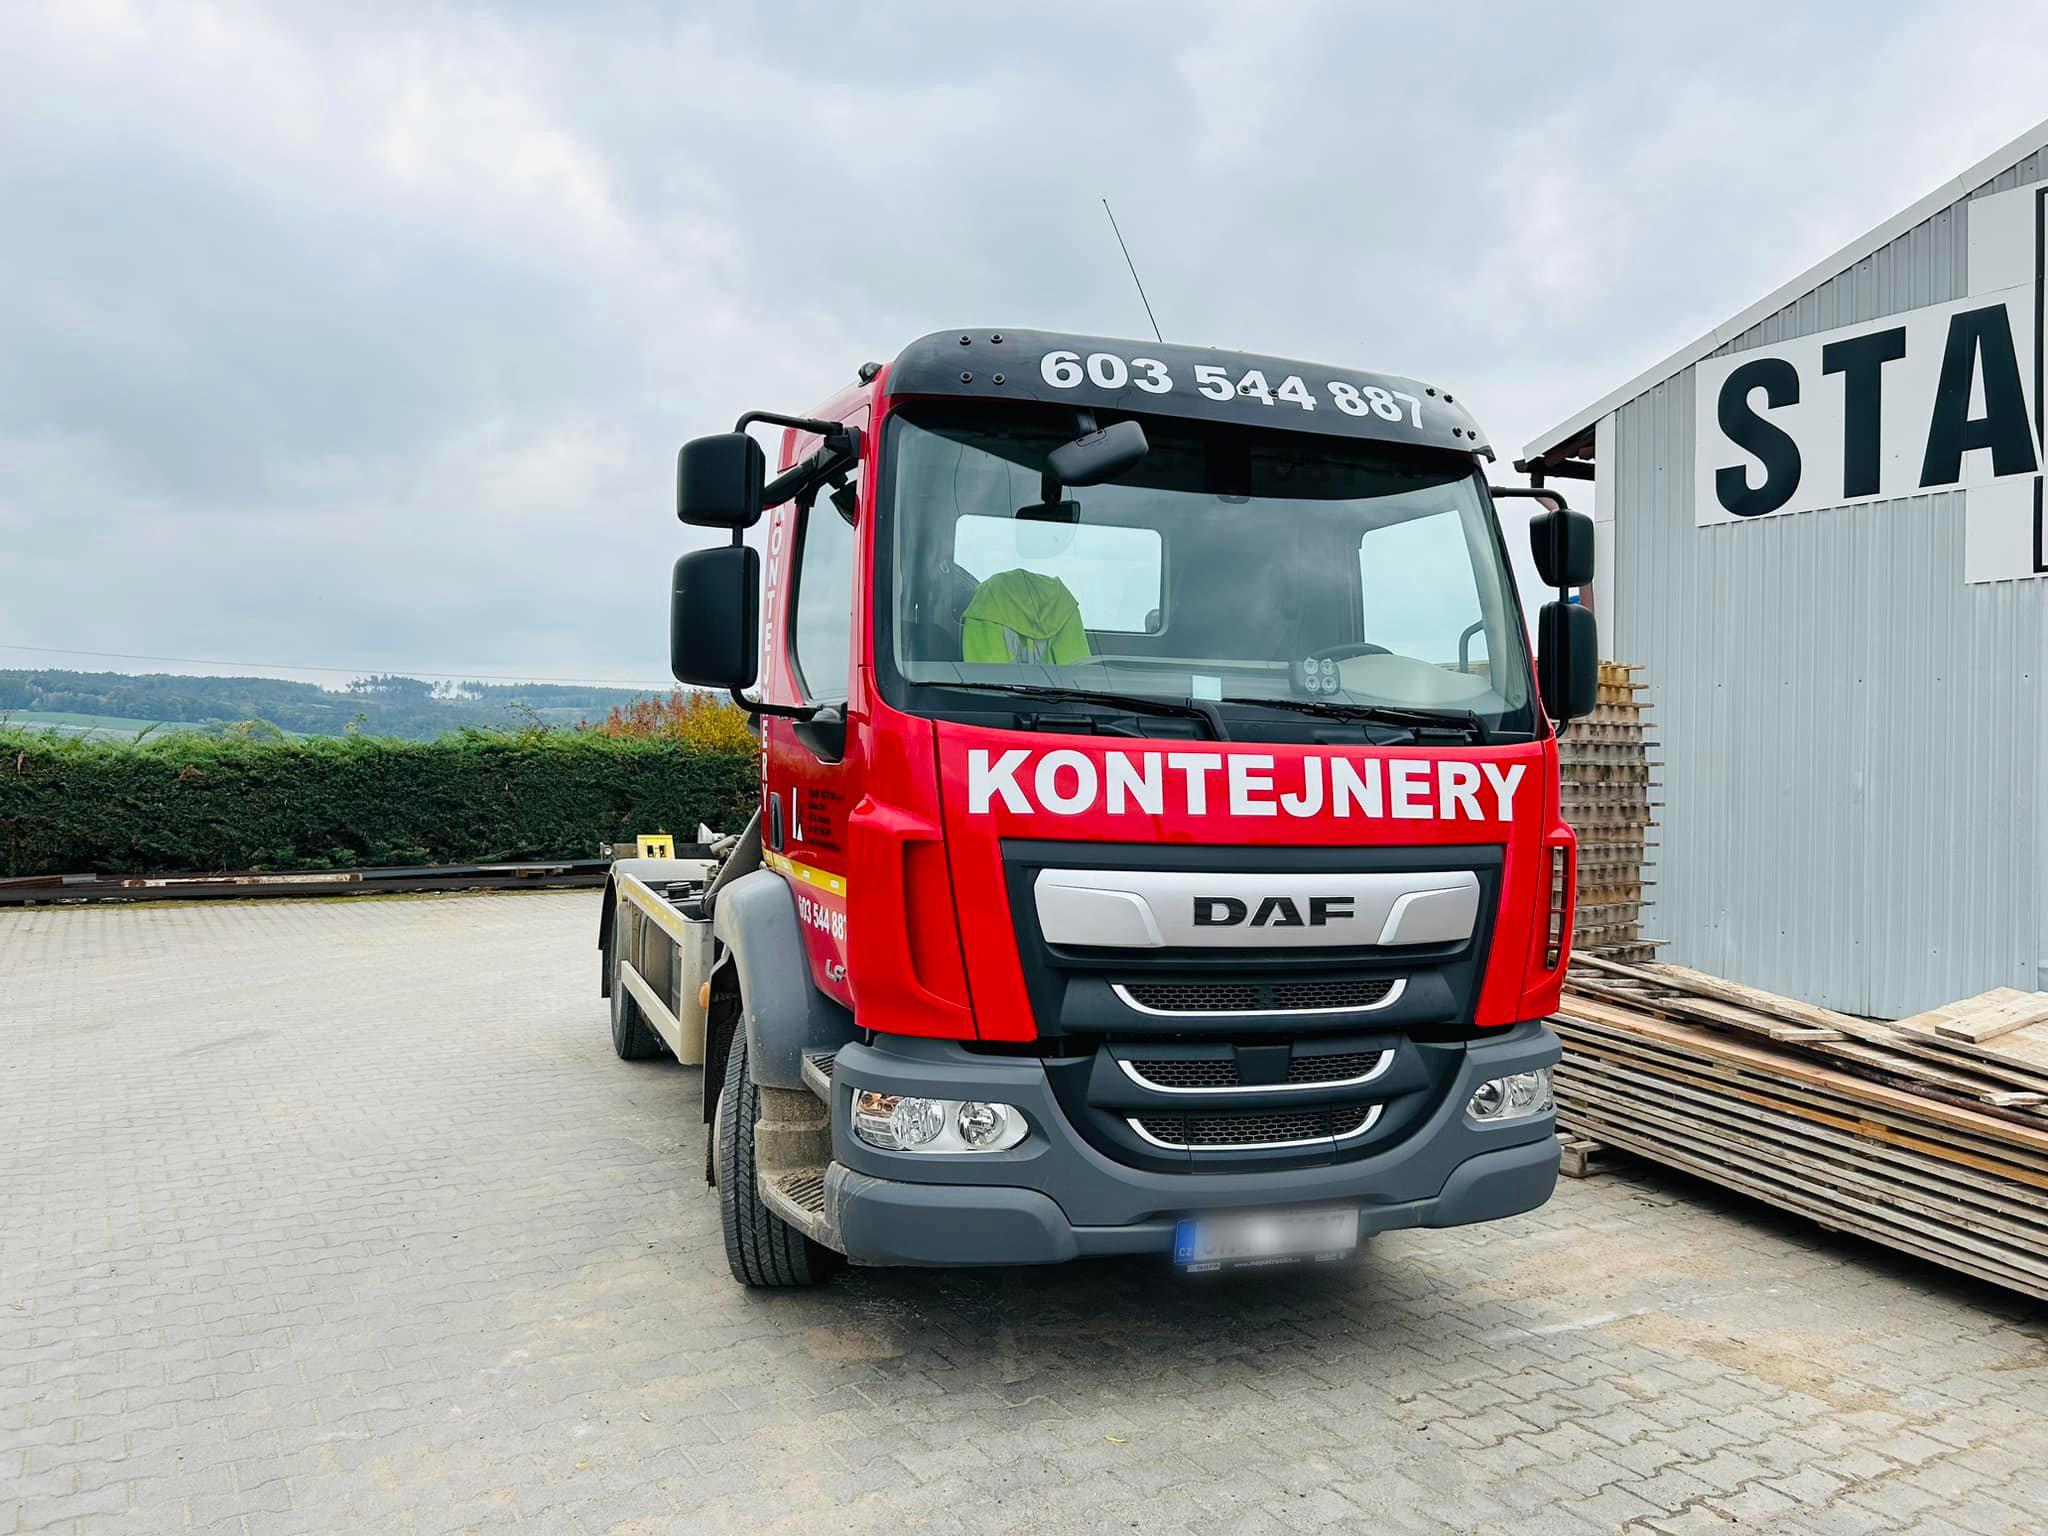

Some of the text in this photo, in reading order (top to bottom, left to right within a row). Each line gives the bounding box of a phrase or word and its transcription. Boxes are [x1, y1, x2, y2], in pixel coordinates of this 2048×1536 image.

[1040, 350, 1424, 429] 603 544 887
[1715, 302, 2039, 517] STA
[967, 749, 1527, 822] KONTEJNERY
[813, 902, 830, 934] 544
[1193, 896, 1355, 926] DAF
[1179, 1247, 1193, 1257] CZ
